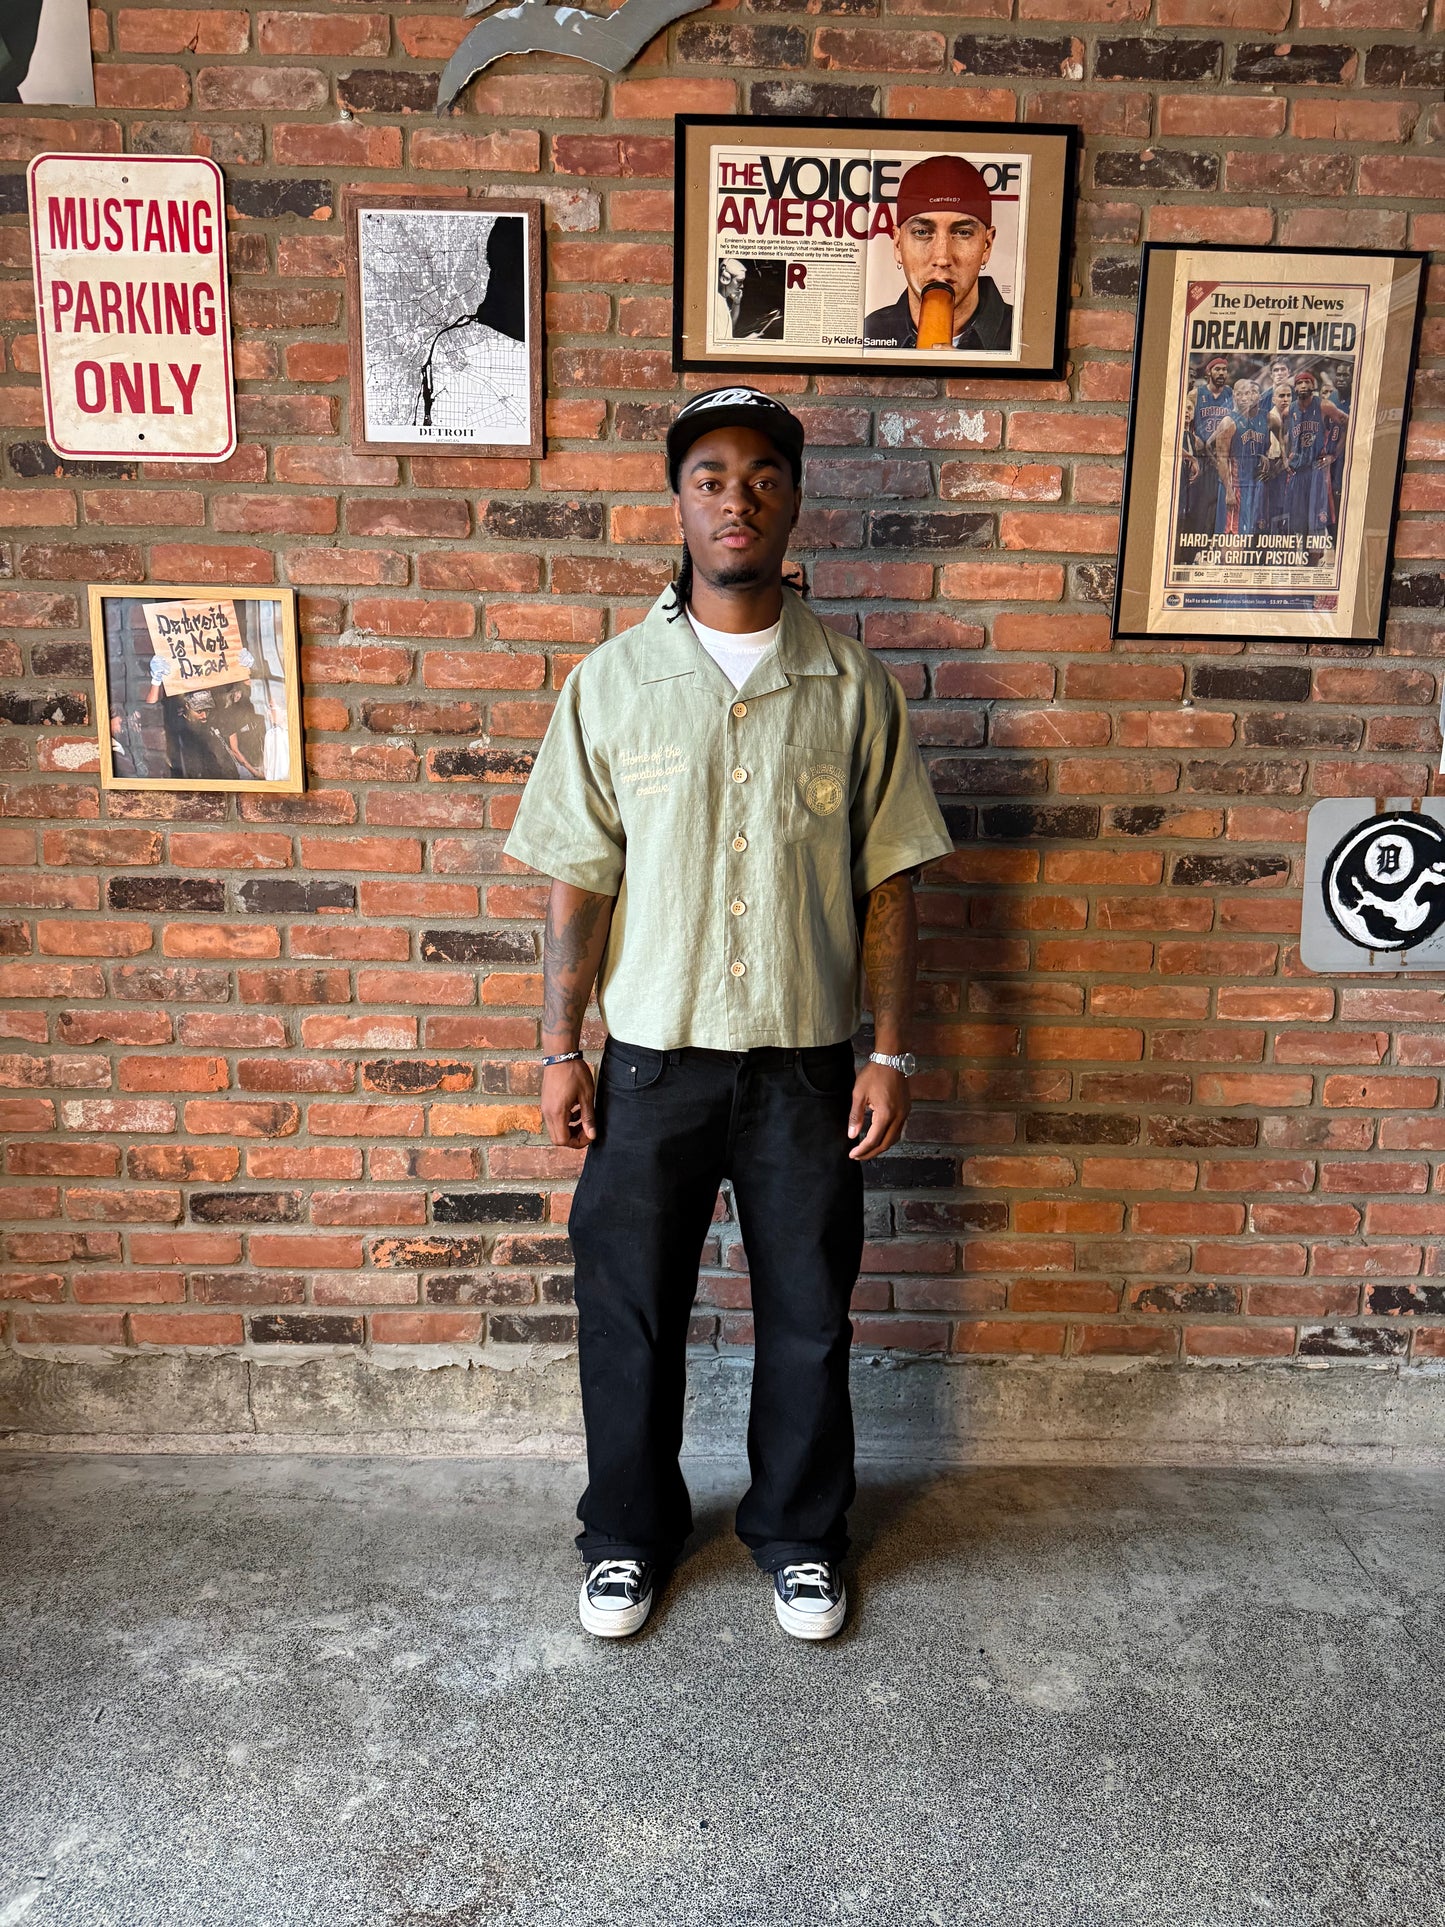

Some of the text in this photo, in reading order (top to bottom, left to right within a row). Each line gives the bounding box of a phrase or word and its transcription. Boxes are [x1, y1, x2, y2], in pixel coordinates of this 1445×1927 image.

[719, 156, 1021, 203] THE VOICE OF
[48, 197, 213, 254] MUSTANG
[717, 196, 894, 240] AMERICA
[787, 263, 807, 289] R
[51, 280, 216, 336] PARKING
[1211, 293, 1344, 311] The Detroit News
[822, 336, 898, 346] By Kelefa Sanneh
[1191, 319, 1357, 352] DREAM DENIED
[75, 360, 202, 415] ONLY
[420, 428, 476, 437] DETROIT
[1179, 533, 1333, 549] HARD-FOUGHT JOURNEY ENDS
[1200, 550, 1310, 565] FOR GRITTY PISTONS
[156, 605, 229, 636] Detroit
[167, 629, 229, 659] is Not
[178, 652, 229, 679] Dead
[620, 743, 682, 767] Home of the
[665, 755, 690, 776] and
[636, 784, 672, 796] creative
